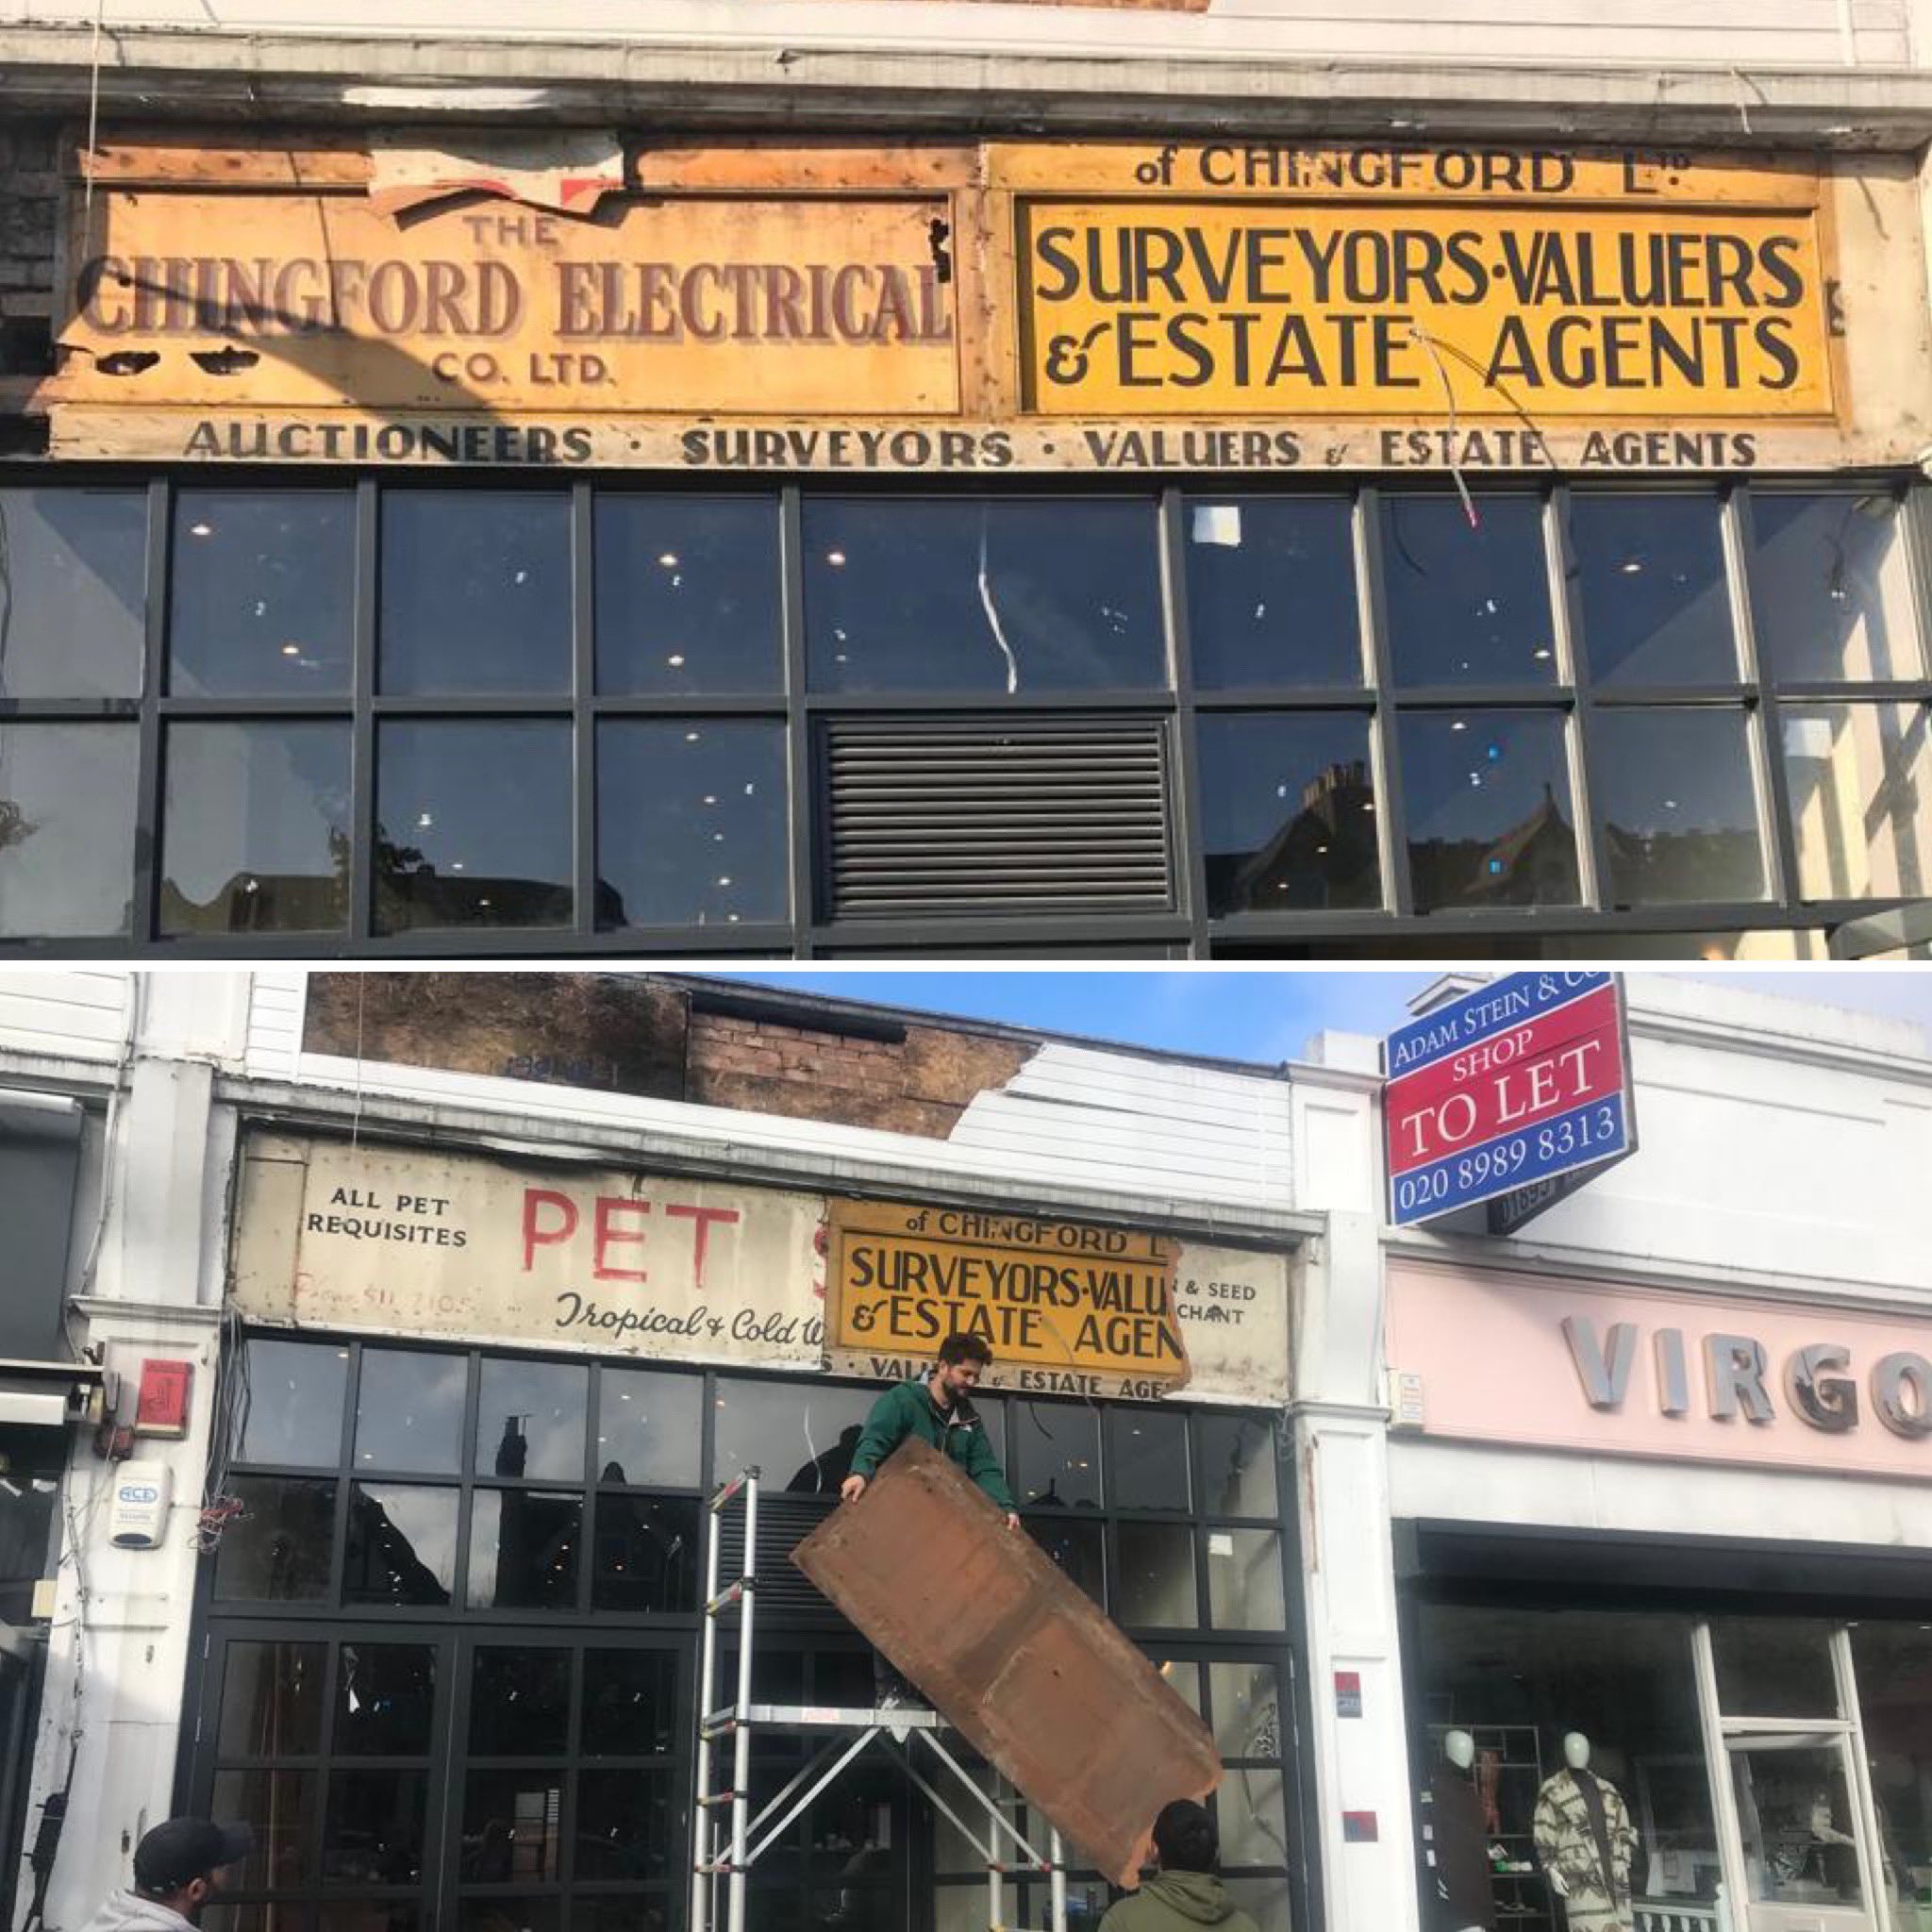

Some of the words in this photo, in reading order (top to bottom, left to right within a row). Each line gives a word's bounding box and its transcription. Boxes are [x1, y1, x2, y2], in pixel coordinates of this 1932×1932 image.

[1136, 143, 1177, 186] of
[462, 215, 559, 246] THE
[77, 255, 525, 338] CHINGFORD
[553, 261, 953, 346] ELECTRICAL
[432, 352, 510, 383] CO.
[530, 353, 616, 385] LTD.
[1117, 312, 1421, 388] ESTATE
[1485, 314, 1800, 391] AGENTS
[184, 420, 593, 463] AUCTIONEERS
[682, 428, 1013, 468] SURVEYORS
[1083, 430, 1301, 468] VALUERS
[1380, 431, 1544, 466] ESTATE
[1580, 431, 1757, 468] AGENTS
[1393, 1021, 1458, 1068] ADAM
[1464, 987, 1531, 1035] STEIN
[1537, 974, 1559, 1001] &
[1452, 1028, 1533, 1081] SHOP
[1401, 1092, 1477, 1158] TO
[1493, 1040, 1601, 1124] LET
[1399, 1168, 1449, 1210] 020
[1457, 1139, 1526, 1190] 8989
[1539, 1106, 1615, 1160] 8313
[330, 1188, 381, 1208] ALL
[396, 1194, 450, 1216] PET
[906, 1209, 929, 1231] of
[308, 1213, 468, 1247] REQUISITES
[521, 1189, 741, 1290] PET
[1185, 1278, 1199, 1295] &
[1208, 1282, 1257, 1301] SEED
[556, 1291, 708, 1339] Tropical
[731, 1307, 796, 1344] Cold
[890, 1295, 1042, 1348] ESTATE
[1020, 1369, 1103, 1395] ESTATE
[1118, 1378, 1171, 1399] AGE
[1561, 1314, 1932, 1441] VIRGO
